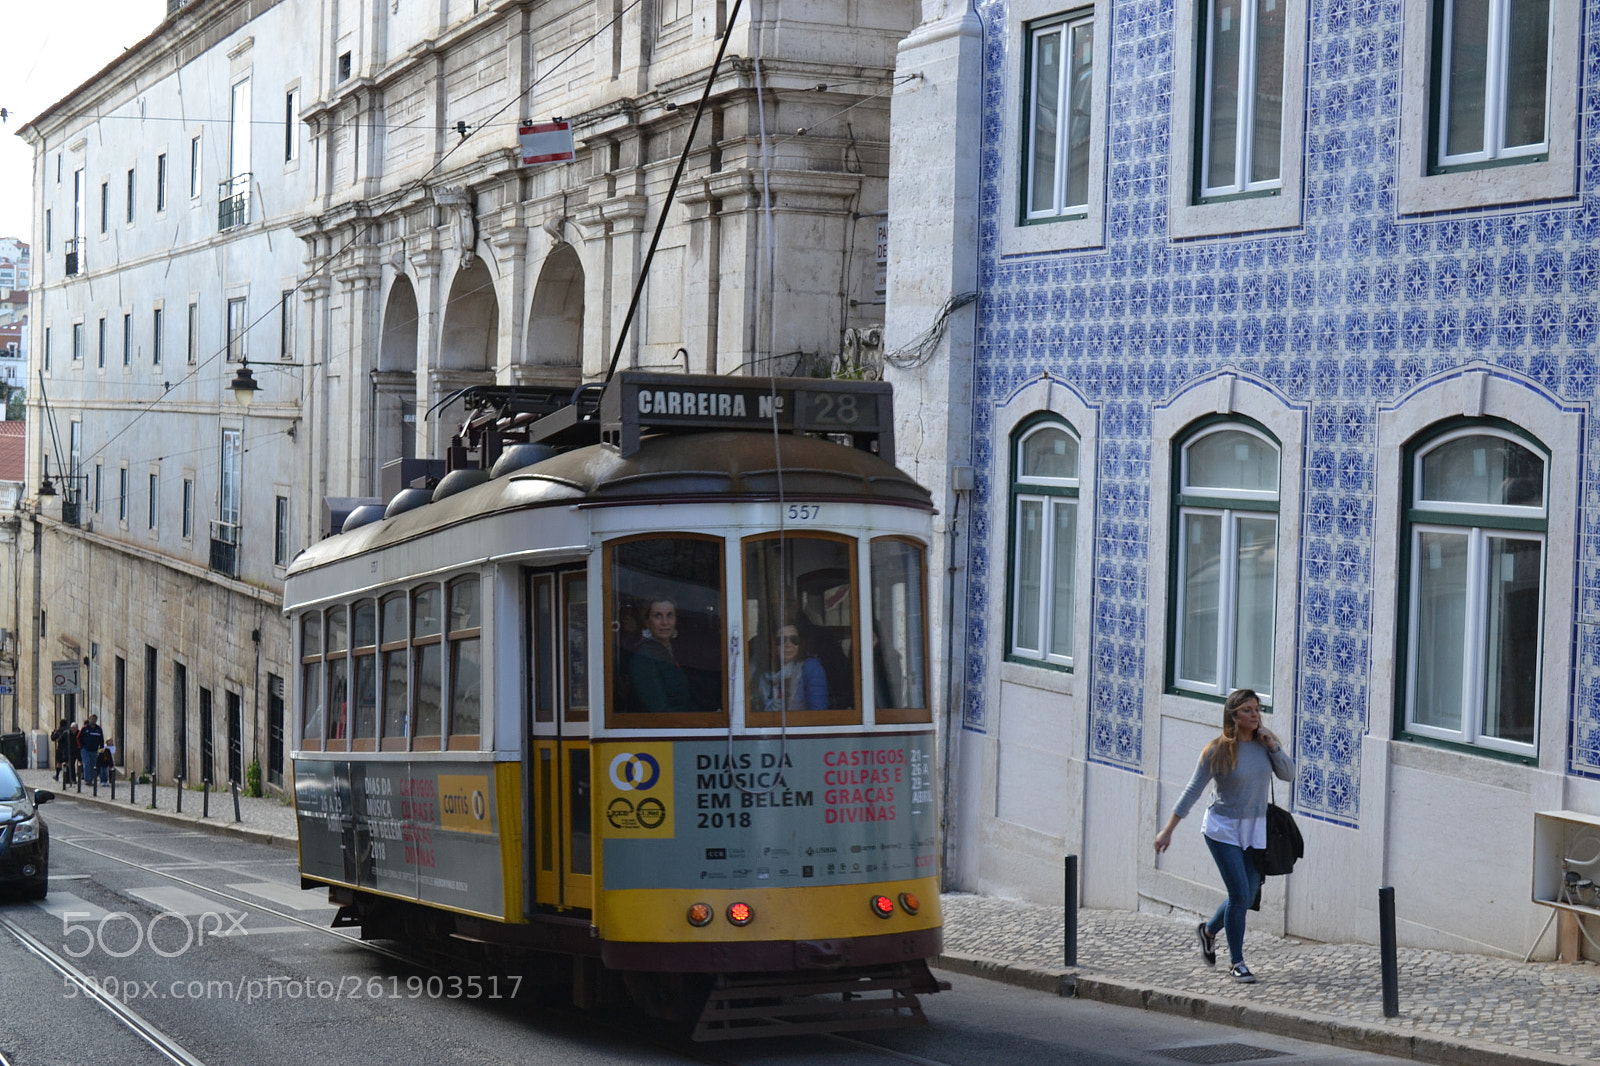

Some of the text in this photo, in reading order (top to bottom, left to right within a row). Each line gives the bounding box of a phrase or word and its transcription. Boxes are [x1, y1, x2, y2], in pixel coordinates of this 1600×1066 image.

[878, 227, 888, 241] PA
[638, 390, 746, 417] CARREIRA
[814, 393, 859, 424] 28
[788, 505, 820, 520] 557
[696, 753, 792, 770] DIAS DA
[824, 749, 908, 767] CASTIGOS,
[697, 769, 787, 789] MÚSICA
[824, 767, 903, 786] CULPAS E
[364, 777, 392, 796] DIAS DA
[443, 787, 469, 815] carris
[697, 788, 814, 809] EM BELÉM
[824, 787, 895, 806] GRAÇAS
[697, 812, 751, 828] 2018
[824, 805, 897, 824] DIVINAS
[367, 820, 379, 838] EM
[370, 842, 386, 860] 2018
